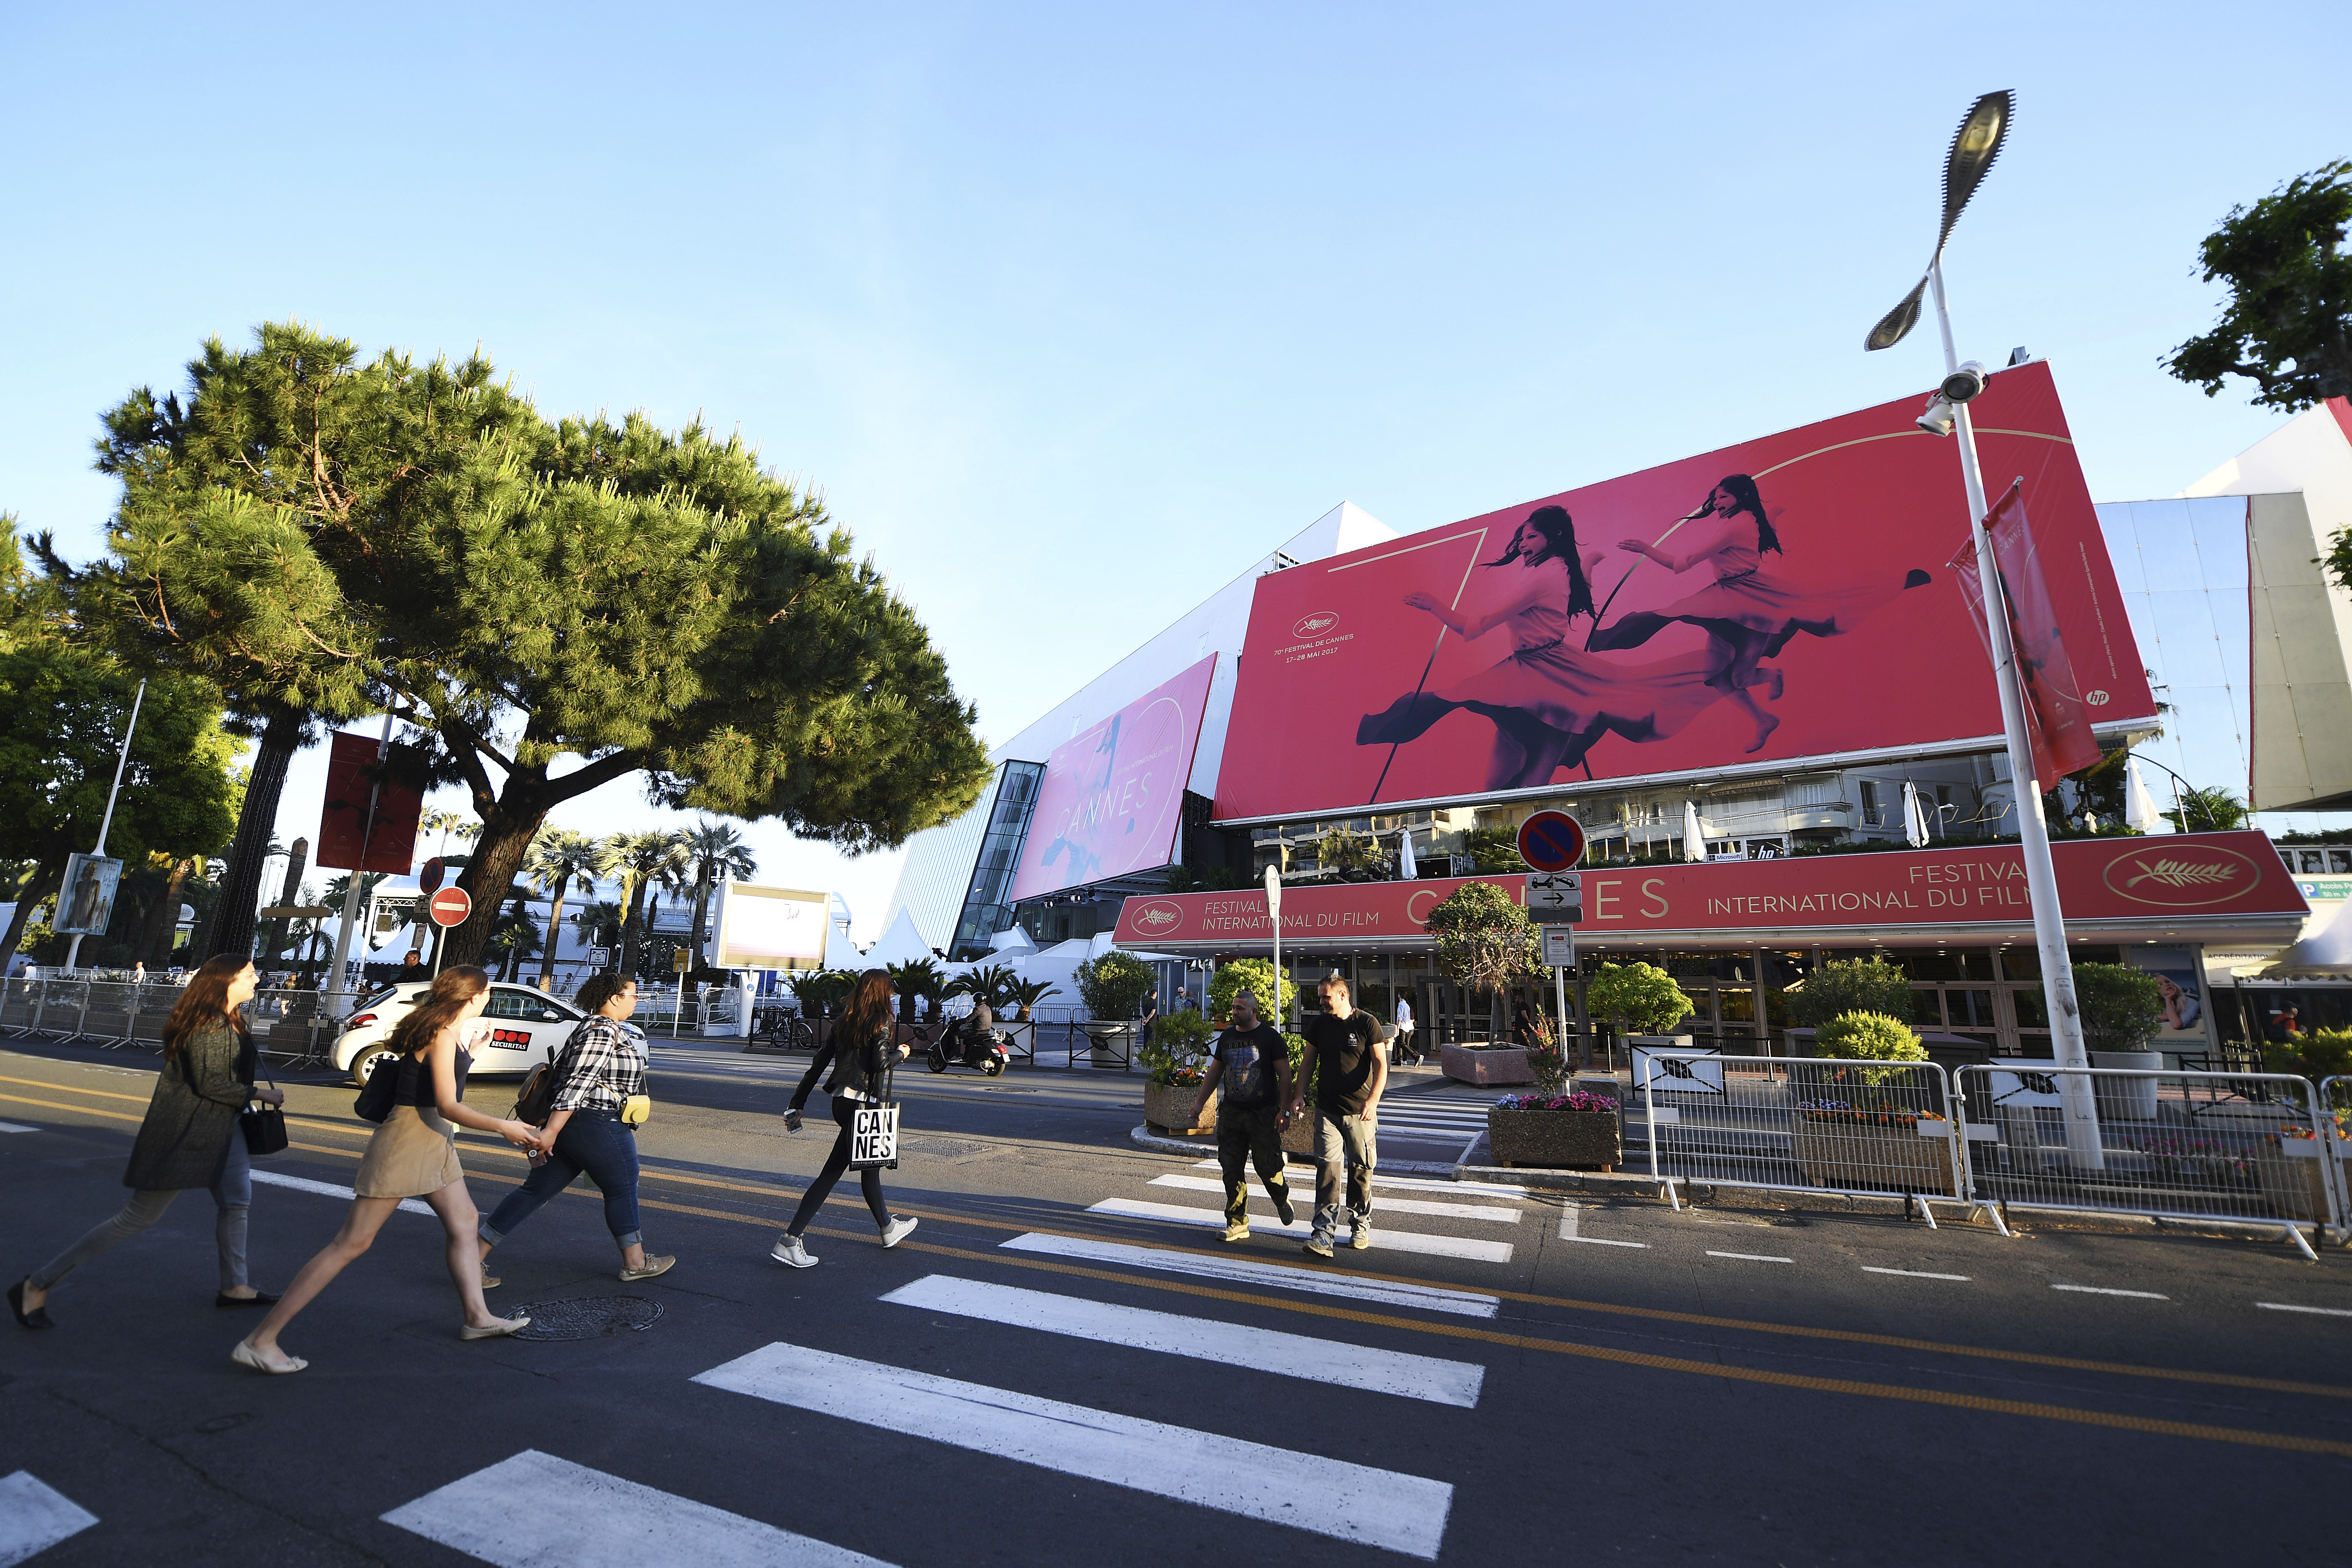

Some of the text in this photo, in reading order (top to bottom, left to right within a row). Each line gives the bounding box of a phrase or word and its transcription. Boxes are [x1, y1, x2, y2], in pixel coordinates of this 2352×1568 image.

[1285, 643, 1314, 653] FESTIVAL
[1326, 634, 1354, 644] CANNES
[1307, 651, 1320, 659] MAI
[1321, 647, 1338, 656] 2017
[2090, 690, 2107, 705] hp
[1055, 772, 1153, 839] CANNES
[1909, 861, 2027, 884] FESTIVA
[1205, 900, 1263, 914] FESTIVAL
[1708, 890, 1919, 915] INTERNATIONAL
[1927, 888, 1968, 907] DU
[1317, 913, 1339, 927] DU
[1342, 911, 1380, 926] FILM
[491, 1041, 526, 1050] SECURITAS
[1228, 1040, 1254, 1048] GOING
[857, 1111, 892, 1135] CAN
[855, 1135, 891, 1159] NES
